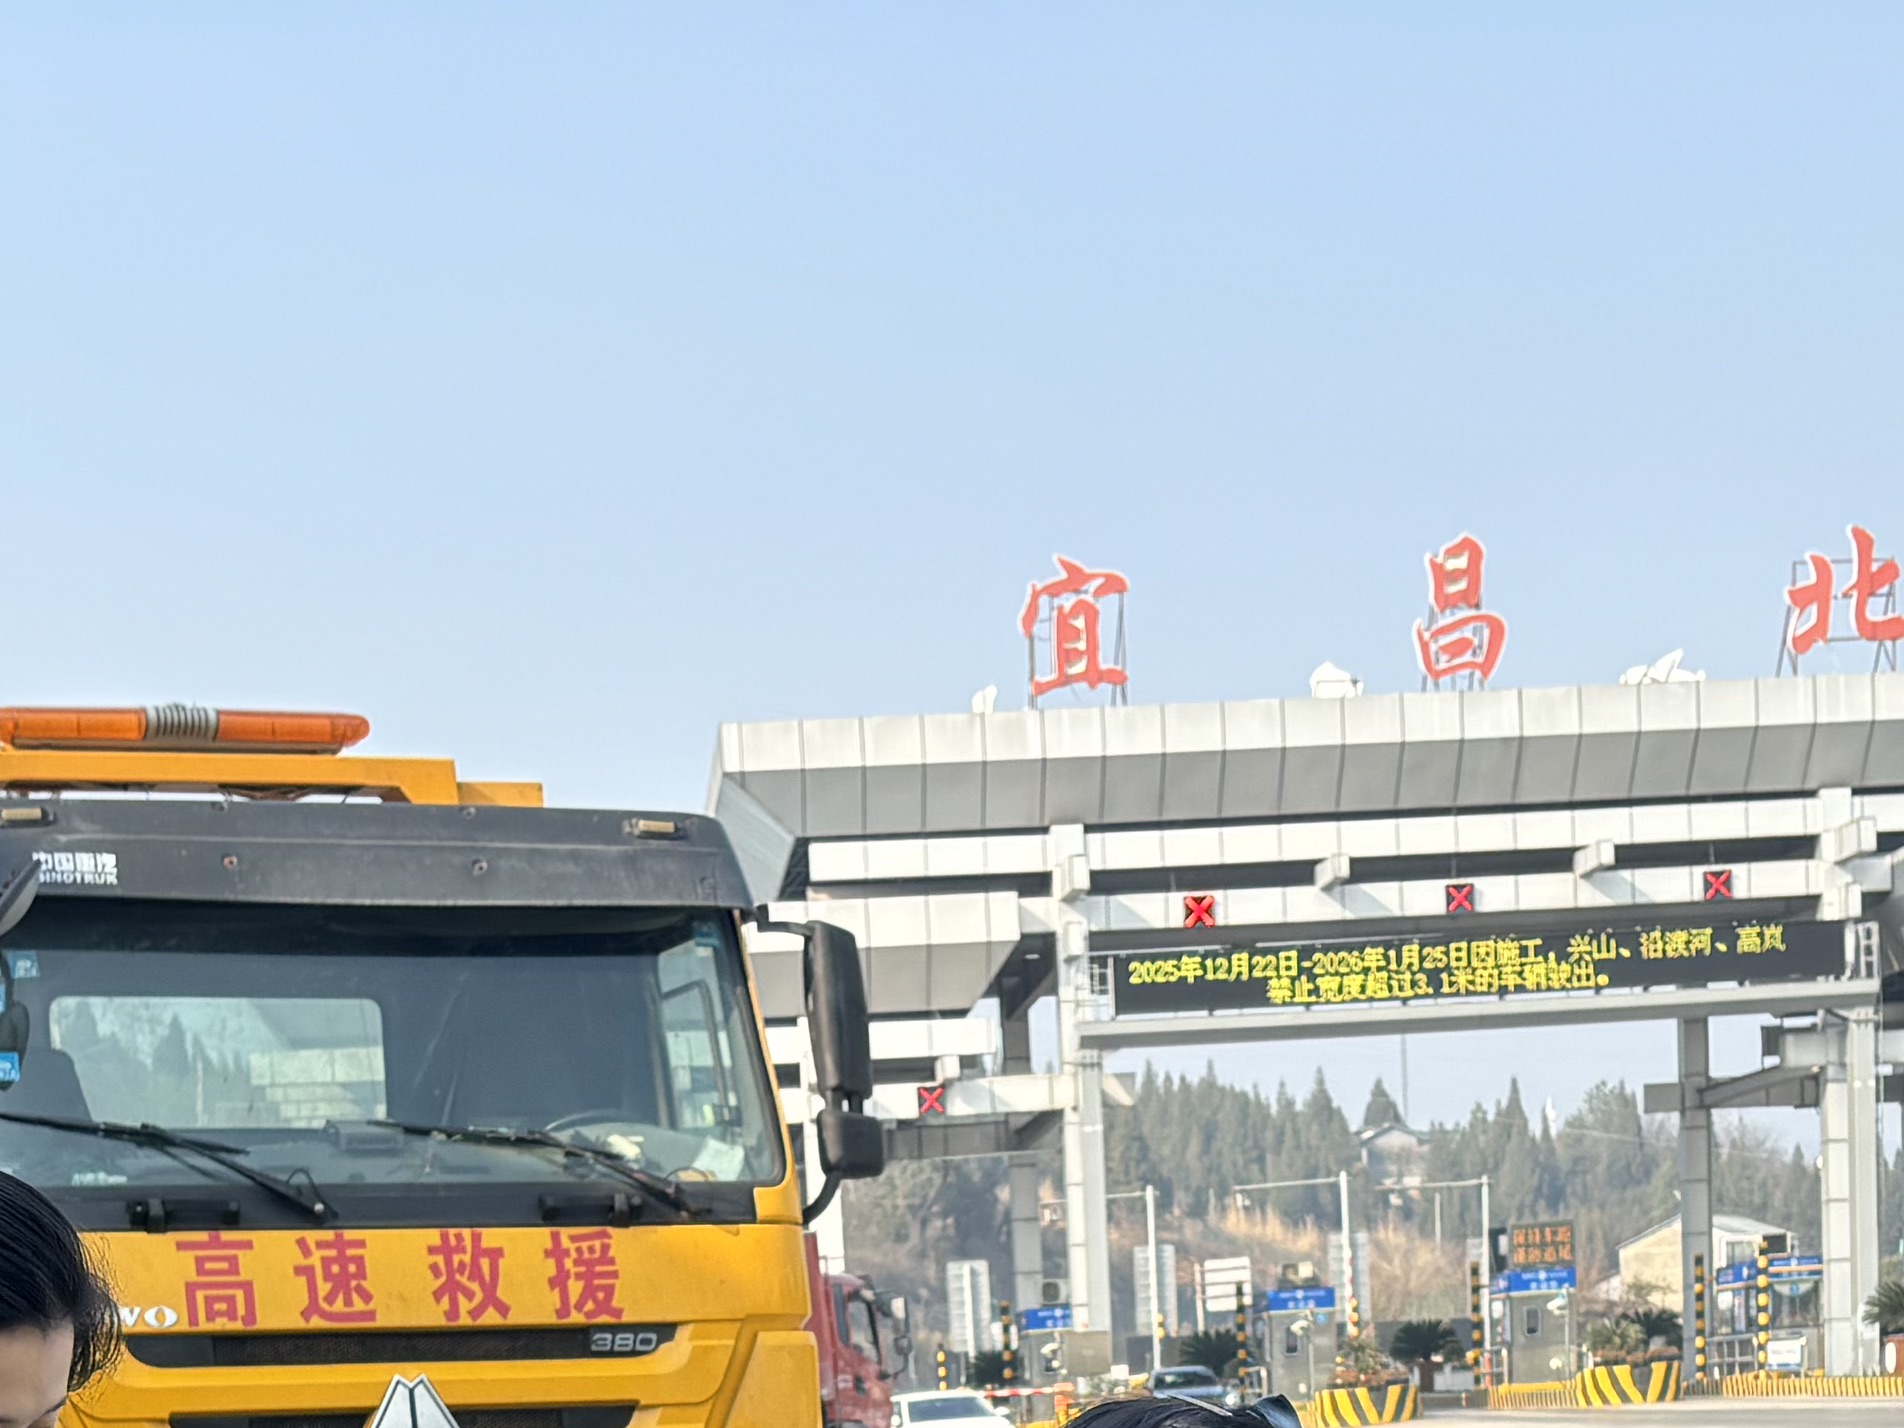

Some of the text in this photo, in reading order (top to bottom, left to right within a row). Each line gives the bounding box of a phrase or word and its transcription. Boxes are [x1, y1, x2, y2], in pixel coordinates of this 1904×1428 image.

[175, 1228, 627, 1329] 高速救援
[590, 1332, 659, 1352] 380
